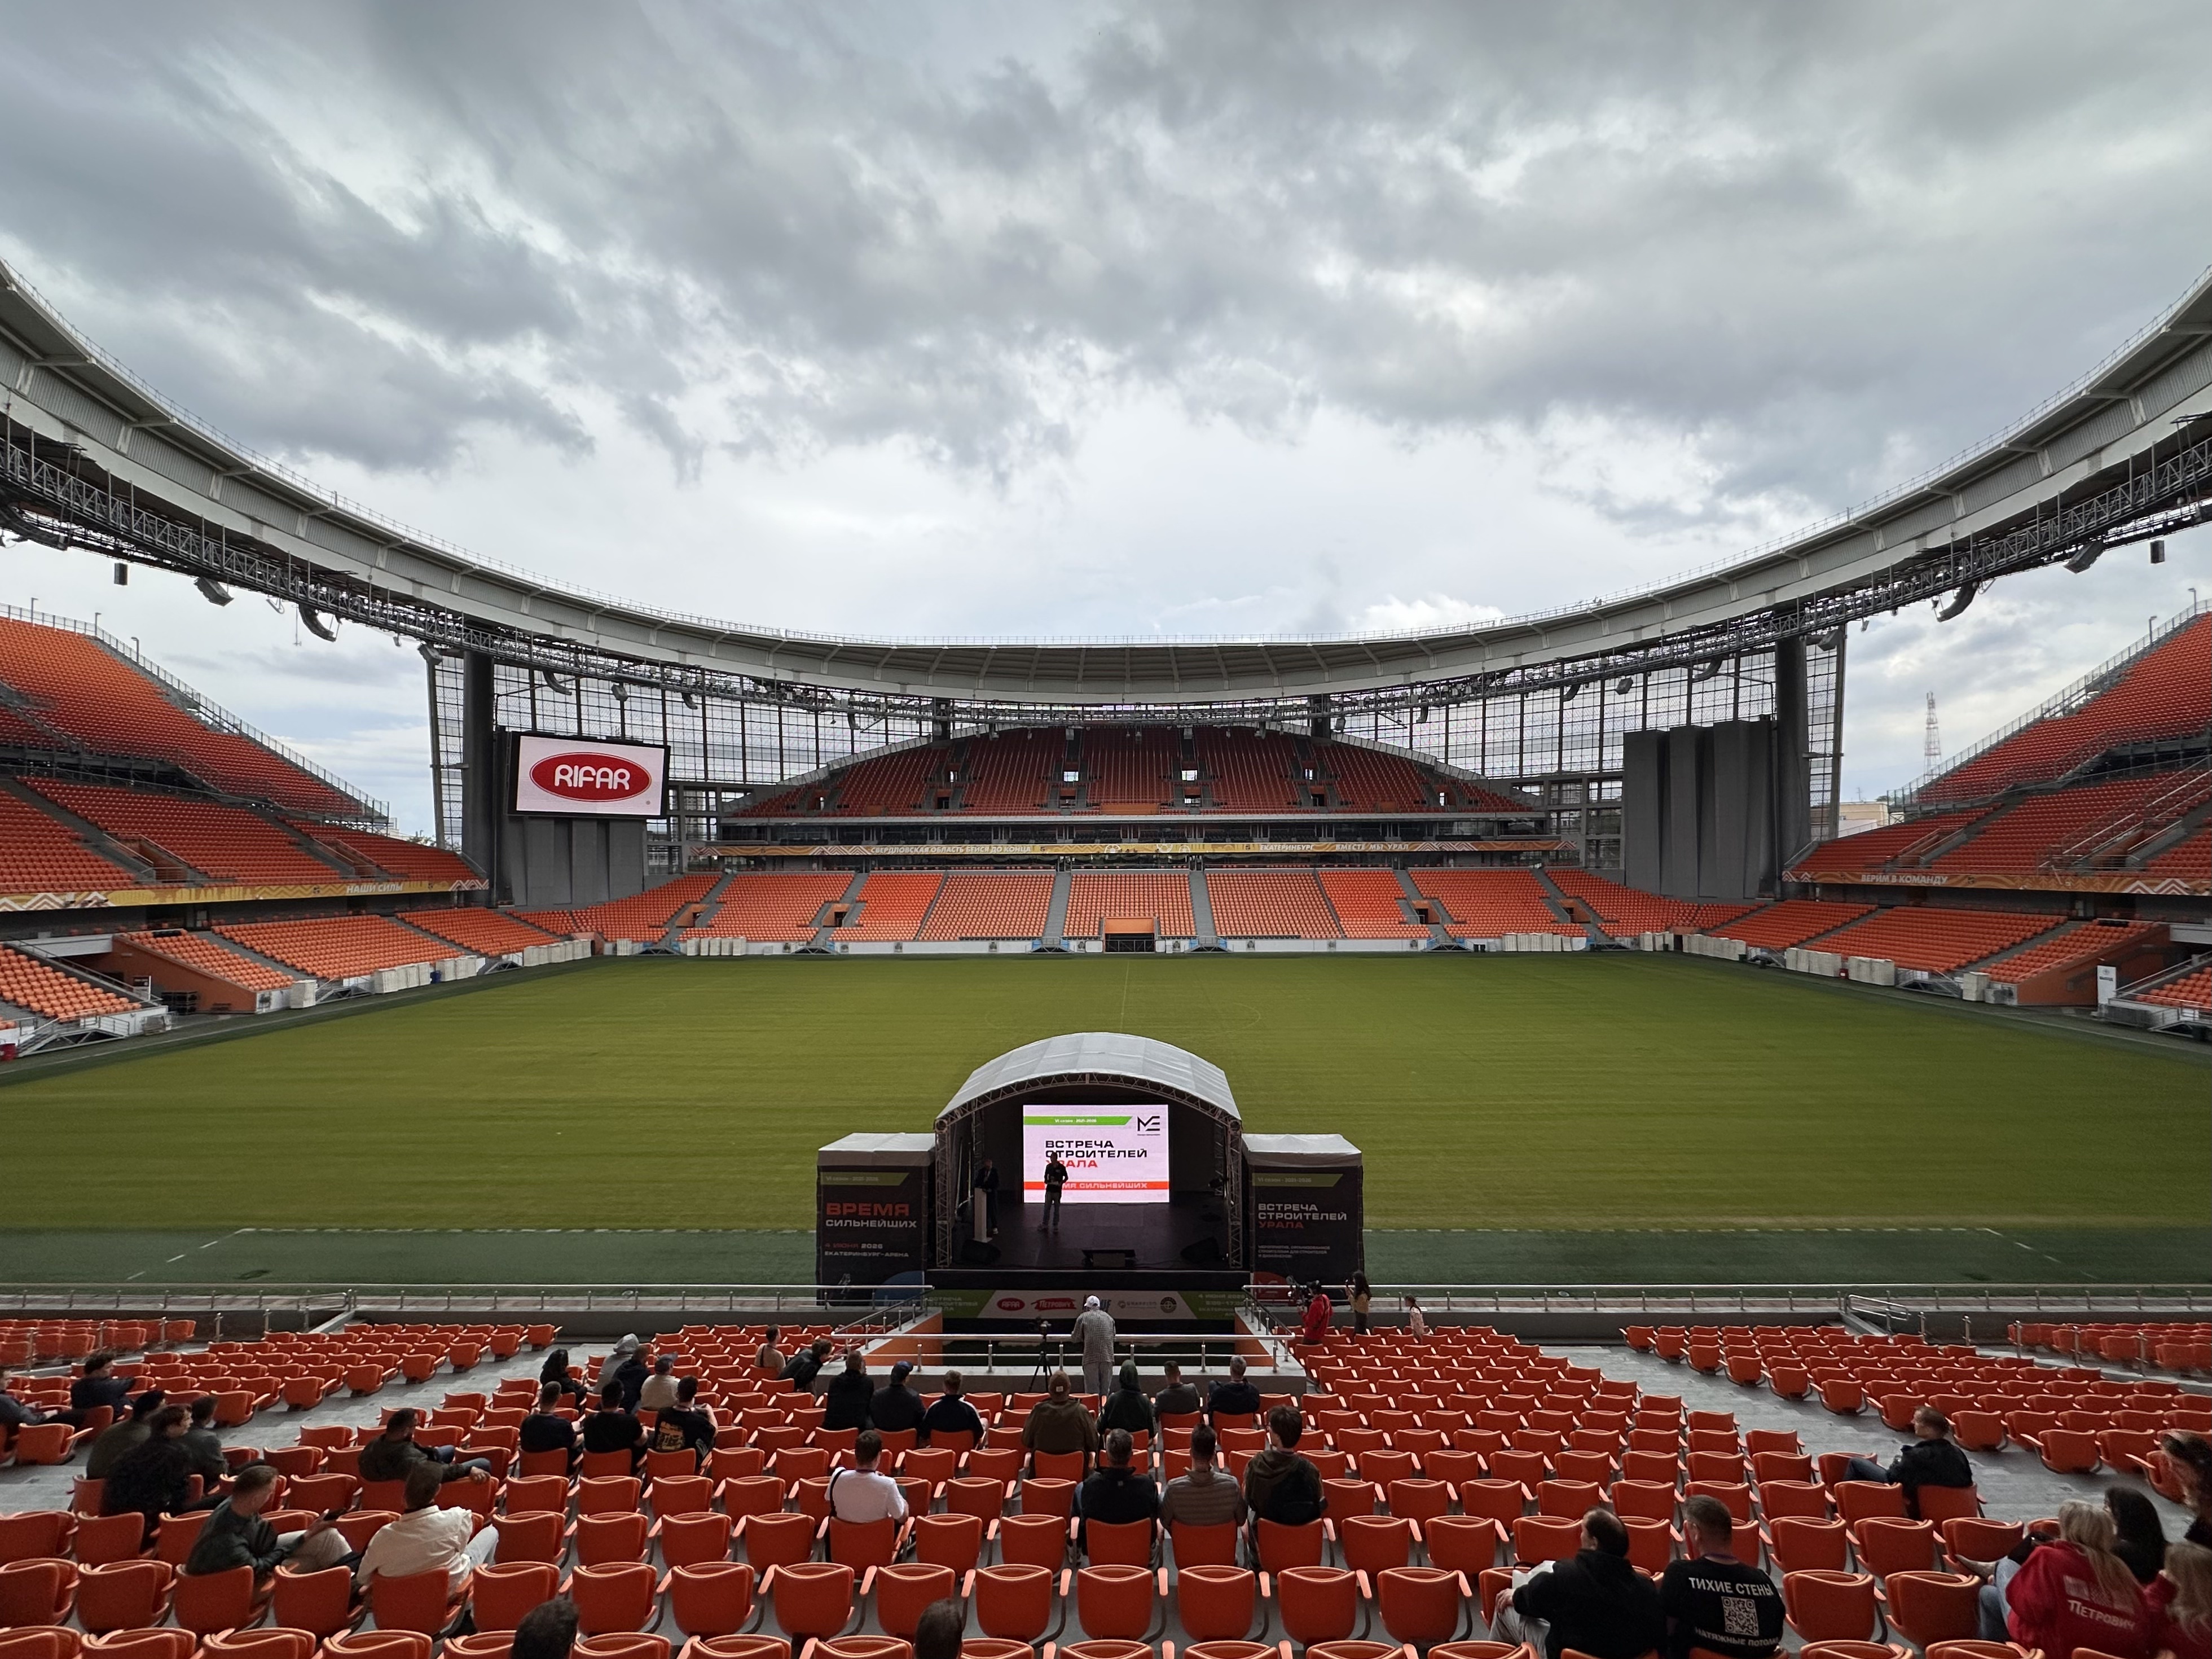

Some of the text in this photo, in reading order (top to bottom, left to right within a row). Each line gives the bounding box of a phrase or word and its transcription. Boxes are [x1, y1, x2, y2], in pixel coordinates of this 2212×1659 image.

[555, 764, 631, 790] RIFAR
[1861, 874, 1889, 883] ВЕРИМ
[1899, 875, 1948, 885] КОМАНДУ
[346, 883, 404, 894] НАШИ СИЛЫ
[1045, 1148, 1147, 1158] СТРОИТЕЛЕЙ
[826, 1202, 910, 1216] ВРЕМЯ
[1258, 1203, 1318, 1212] ВСТРЕЧА
[1258, 1212, 1347, 1221] СТРОИТЕЛЕЙ
[825, 1219, 917, 1228] СИЛЬНЕЙШИХ
[1688, 1577, 1774, 1596] ТИХИЕ СТЕНЫ
[2067, 1599, 2136, 1631] ПЕТРОВИЧ
[1695, 1626, 1746, 1645] НАТЯЖНЫЕ
